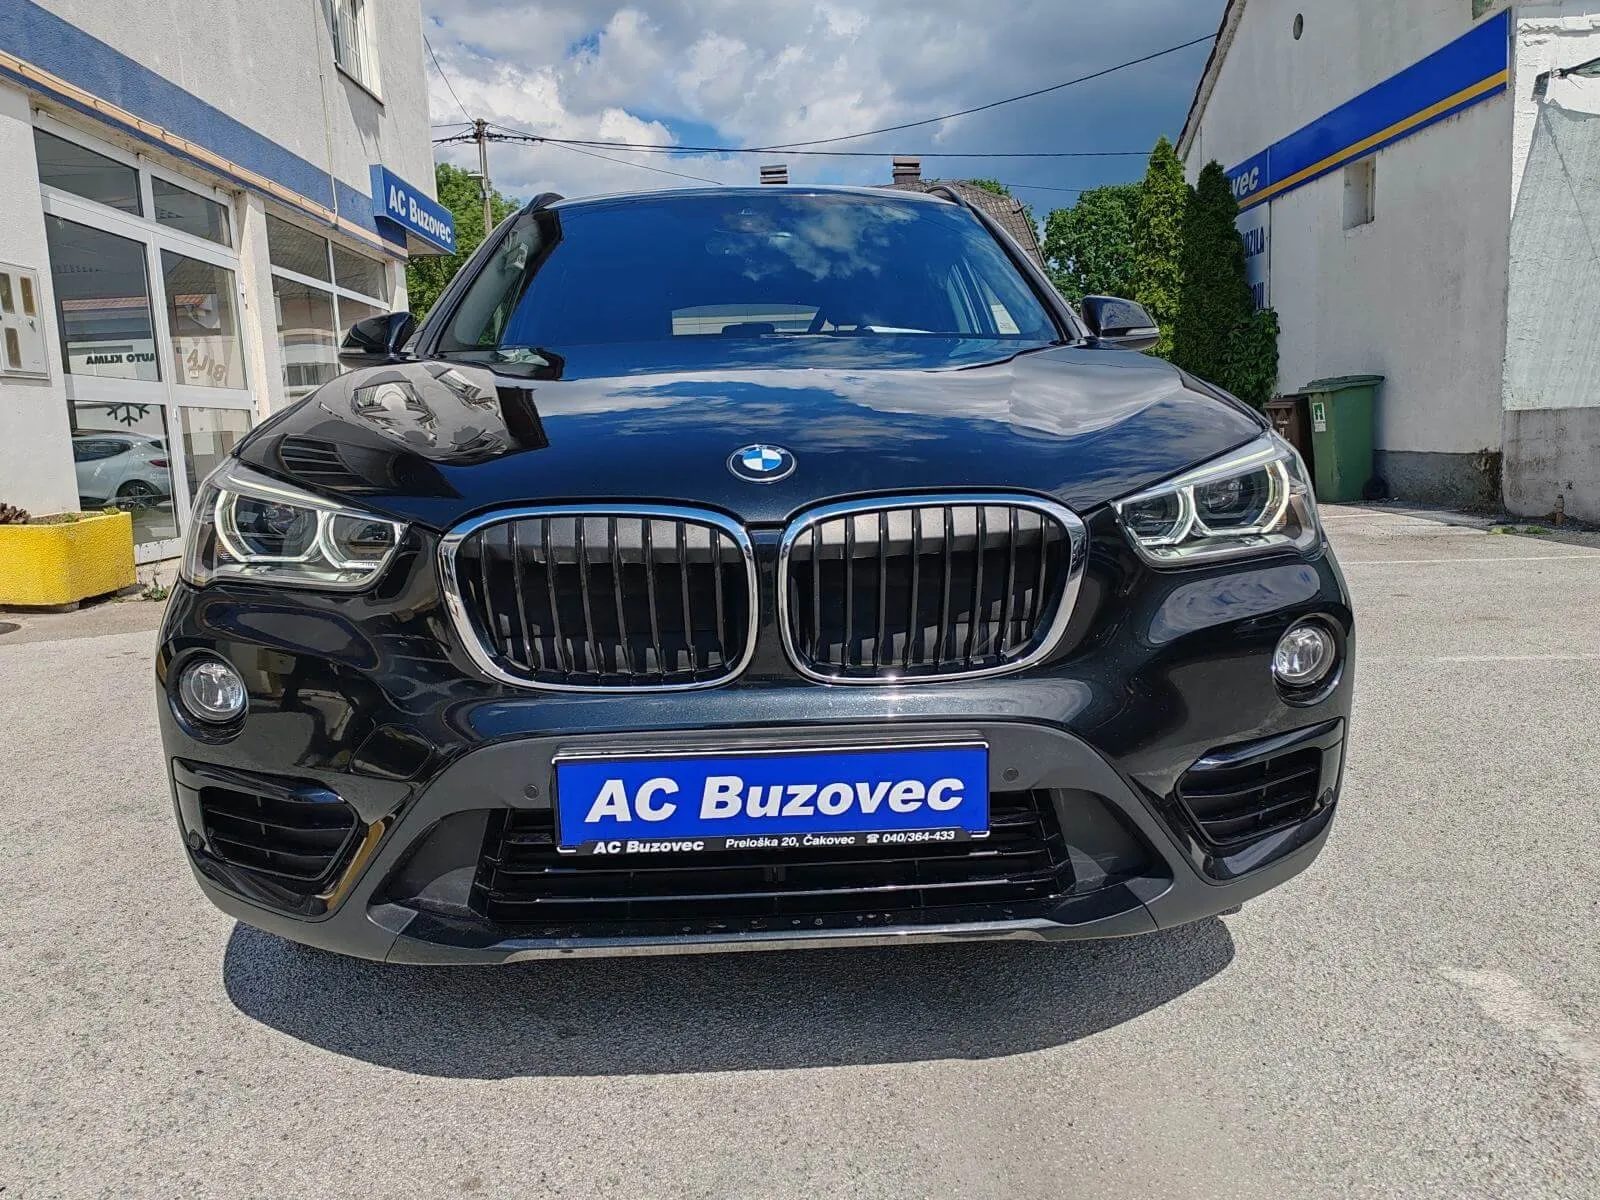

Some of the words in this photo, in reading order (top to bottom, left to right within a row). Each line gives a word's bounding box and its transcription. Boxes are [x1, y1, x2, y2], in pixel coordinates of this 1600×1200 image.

[1230, 166, 1259, 196] vec
[389, 185, 406, 216] AC
[409, 197, 452, 243] Buzovec
[1243, 226, 1265, 259] OZILA
[584, 777, 680, 823] AC
[699, 775, 965, 819] Buzovec
[593, 841, 622, 855] AC
[626, 840, 705, 854] Buzovec
[725, 837, 779, 849] Preloška
[781, 836, 800, 848] 20,
[803, 834, 856, 846] Čakovec
[882, 830, 955, 843] 040/364-433
